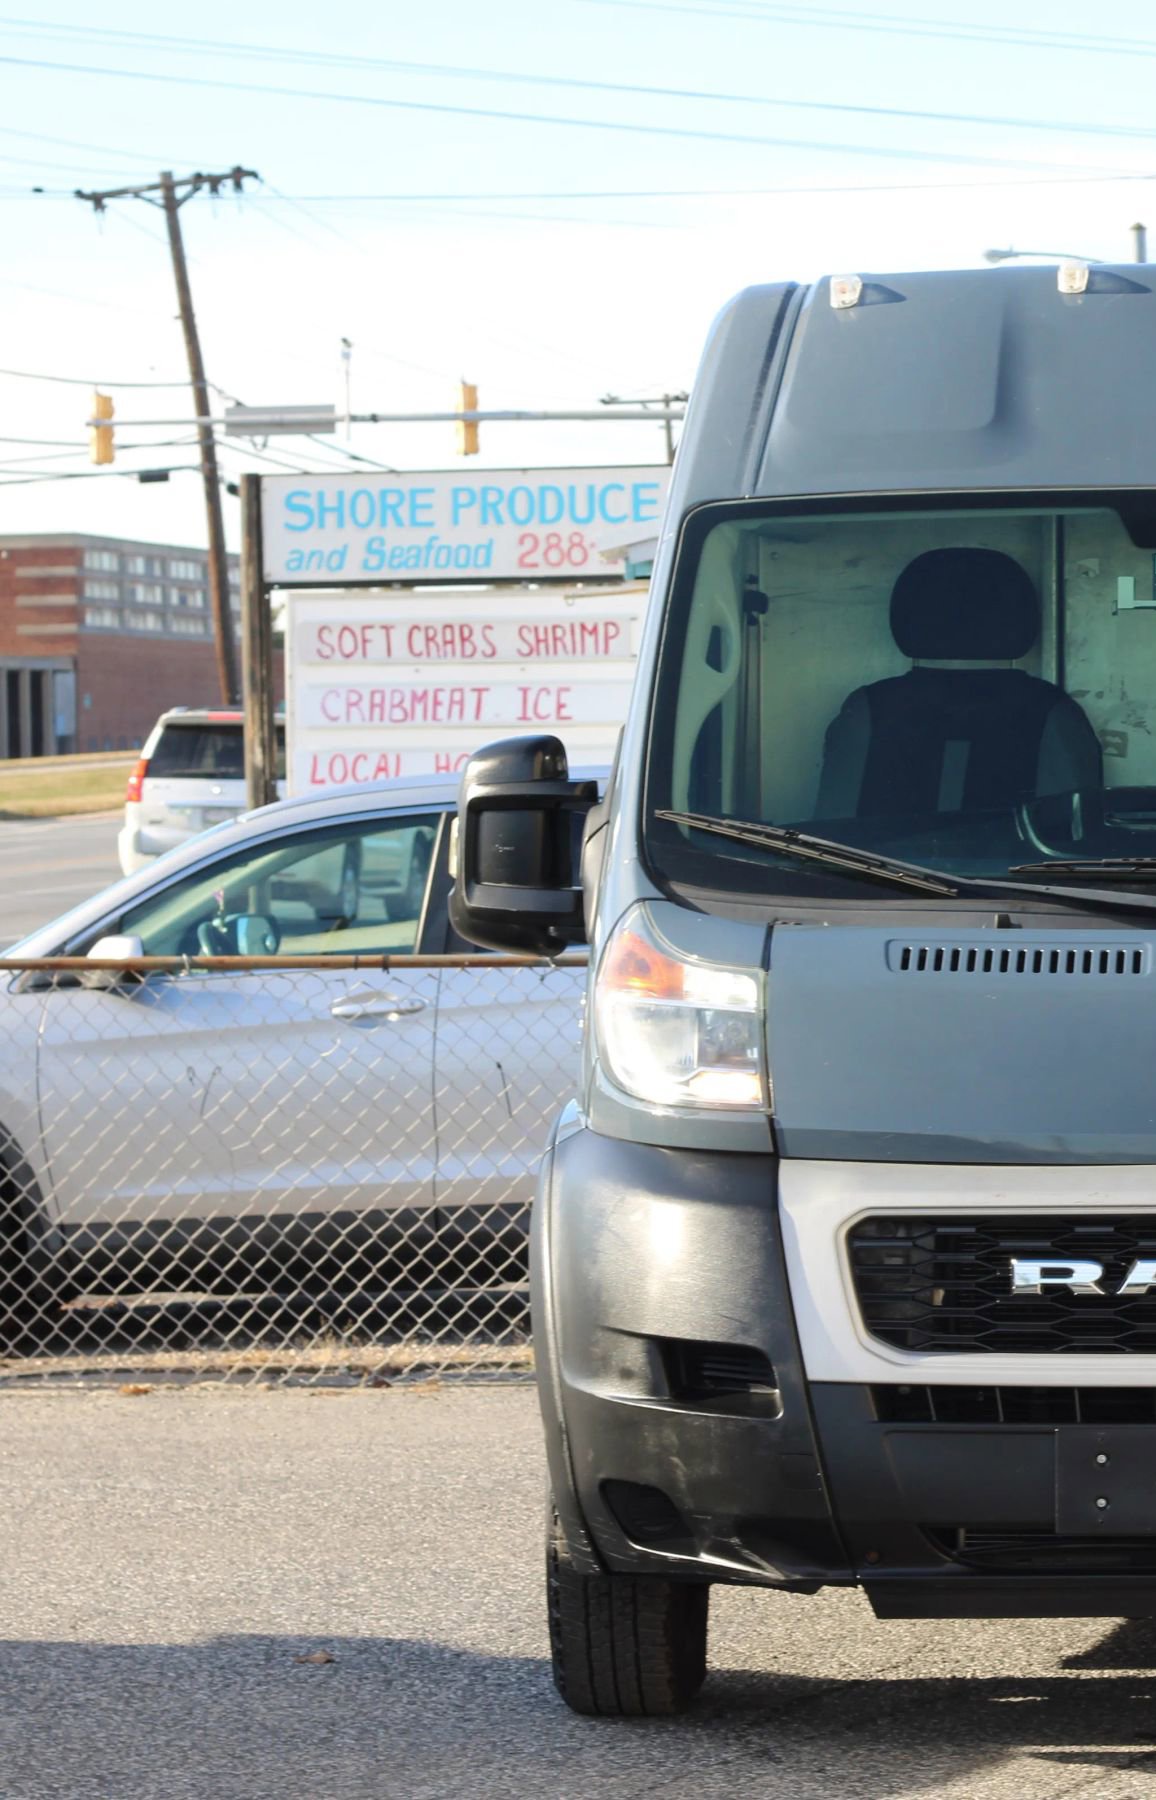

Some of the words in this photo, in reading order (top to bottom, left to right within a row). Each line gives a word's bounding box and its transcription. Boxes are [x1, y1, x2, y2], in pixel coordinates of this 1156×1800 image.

[283, 488, 436, 532] SHORE
[451, 482, 660, 526] PRODUCE
[286, 543, 349, 573] and
[362, 535, 494, 572] Seafood
[316, 624, 395, 660] SOFT
[407, 623, 497, 659] CRABS
[517, 620, 620, 658] SHRIMP
[321, 687, 490, 724] CRABMEAT
[518, 687, 573, 721] ICE
